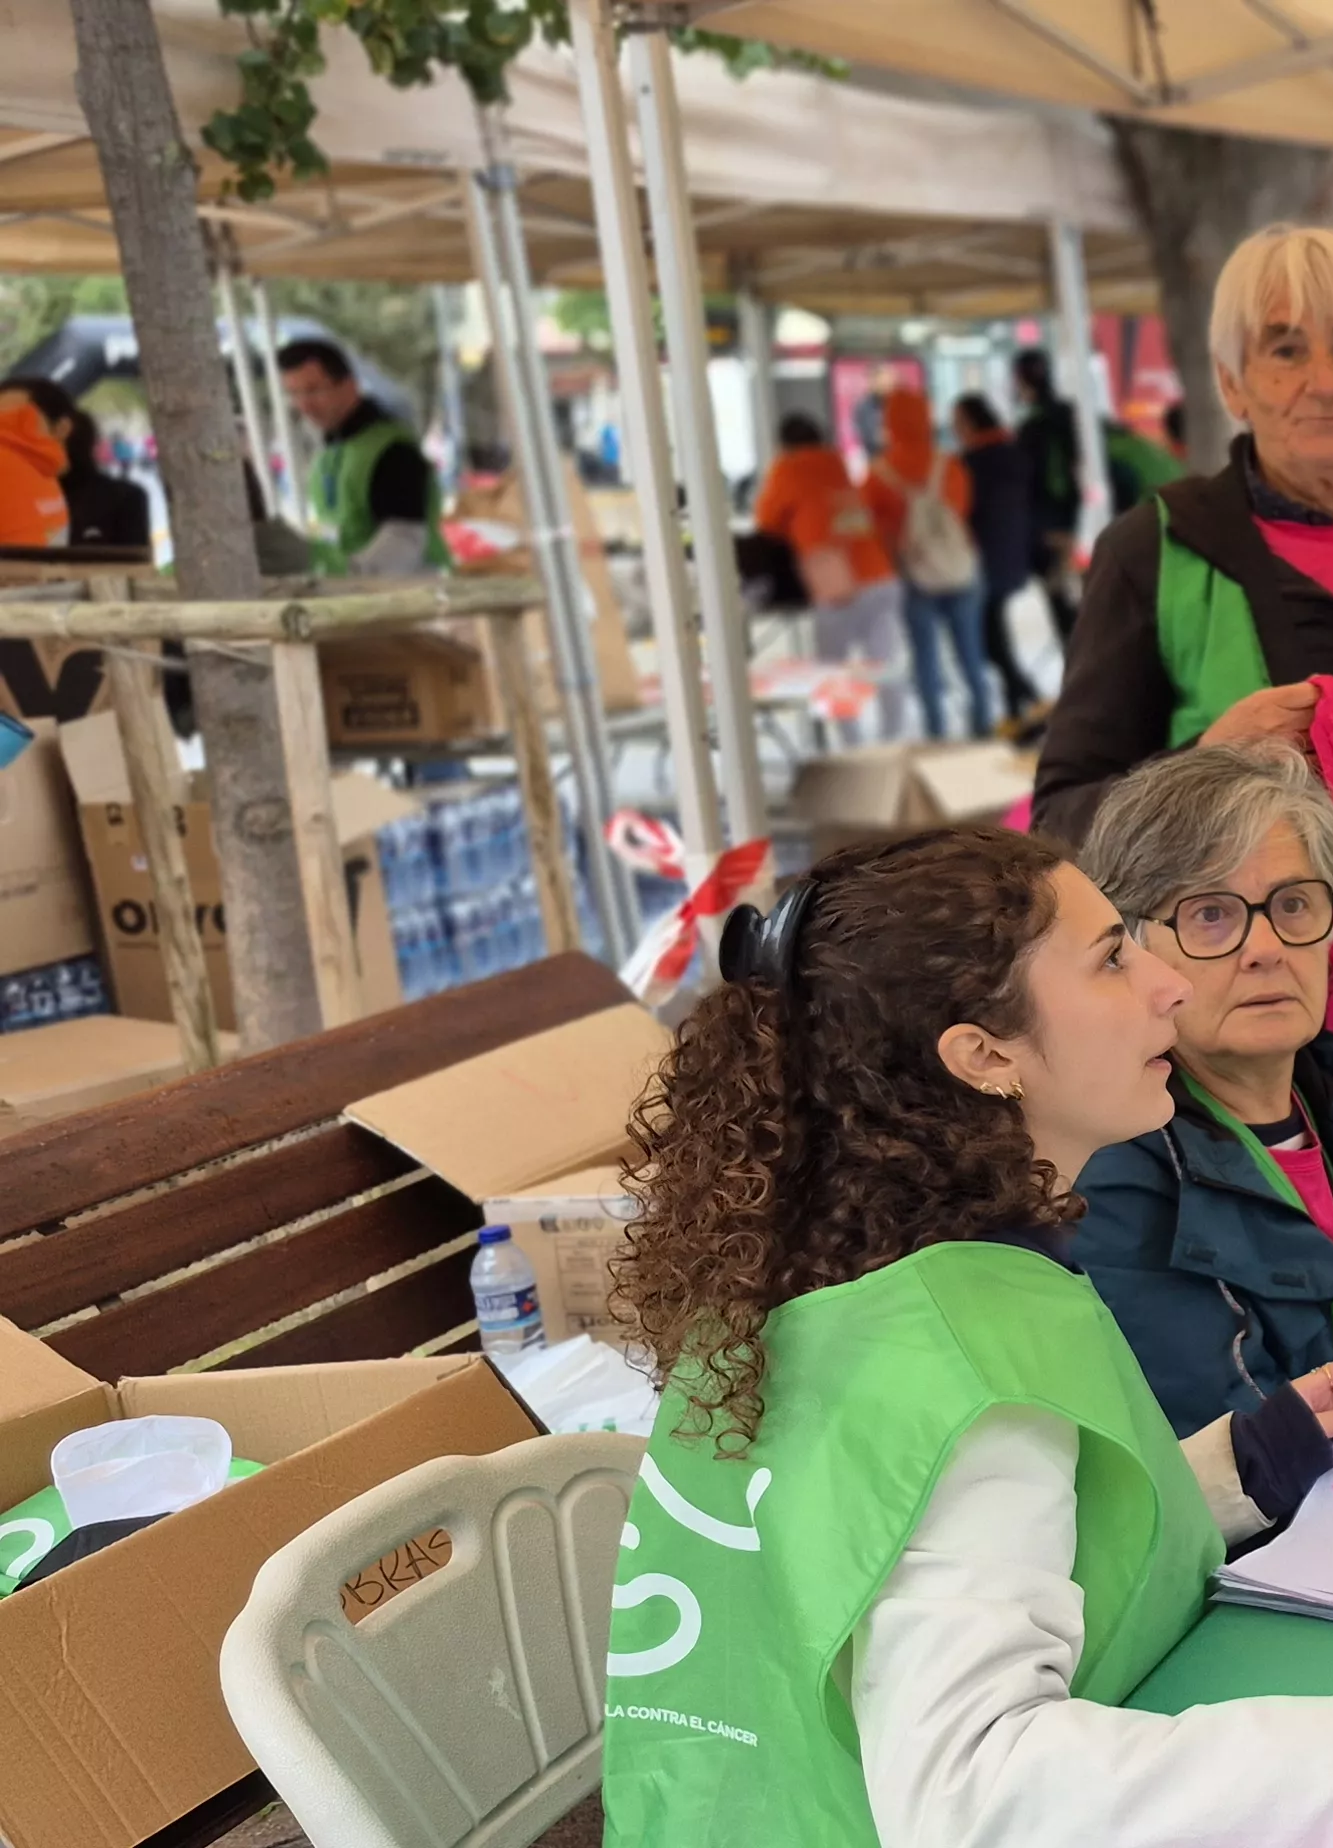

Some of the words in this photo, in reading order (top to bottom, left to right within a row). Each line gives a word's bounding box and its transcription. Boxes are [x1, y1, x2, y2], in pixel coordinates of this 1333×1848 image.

[627, 1705, 688, 1727] CONTRA
[689, 1715, 706, 1732] EL
[707, 1720, 759, 1748] CÁNCER
